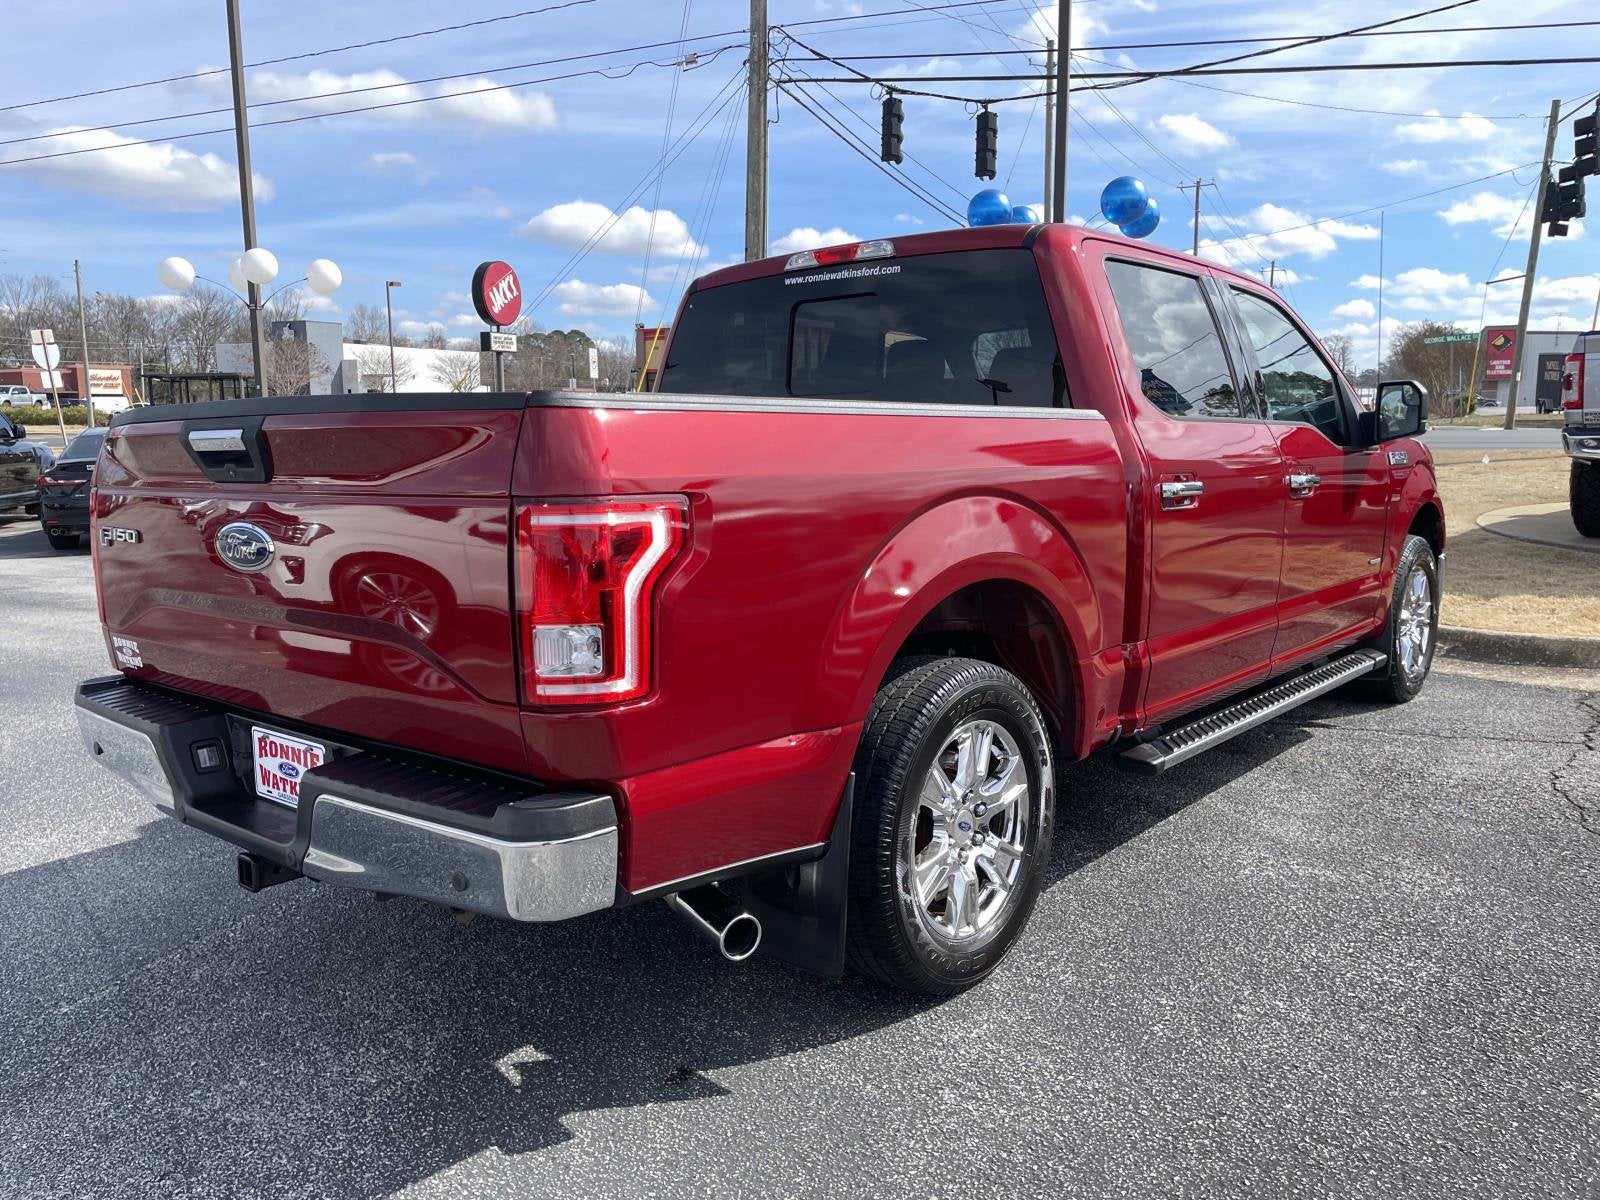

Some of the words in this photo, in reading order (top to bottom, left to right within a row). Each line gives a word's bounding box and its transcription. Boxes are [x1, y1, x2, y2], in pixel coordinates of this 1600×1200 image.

[784, 265, 901, 285] www.ronniewatkinsford.com
[1423, 336, 1446, 344] GEORGE
[1447, 333, 1472, 342] WALLACE
[226, 532, 257, 560] Ford
[112, 636, 140, 654] RONNIE
[116, 650, 144, 668] WATKINS
[257, 737, 320, 770] RONNIE
[280, 763, 298, 777] Ford
[259, 763, 299, 797] WATK
